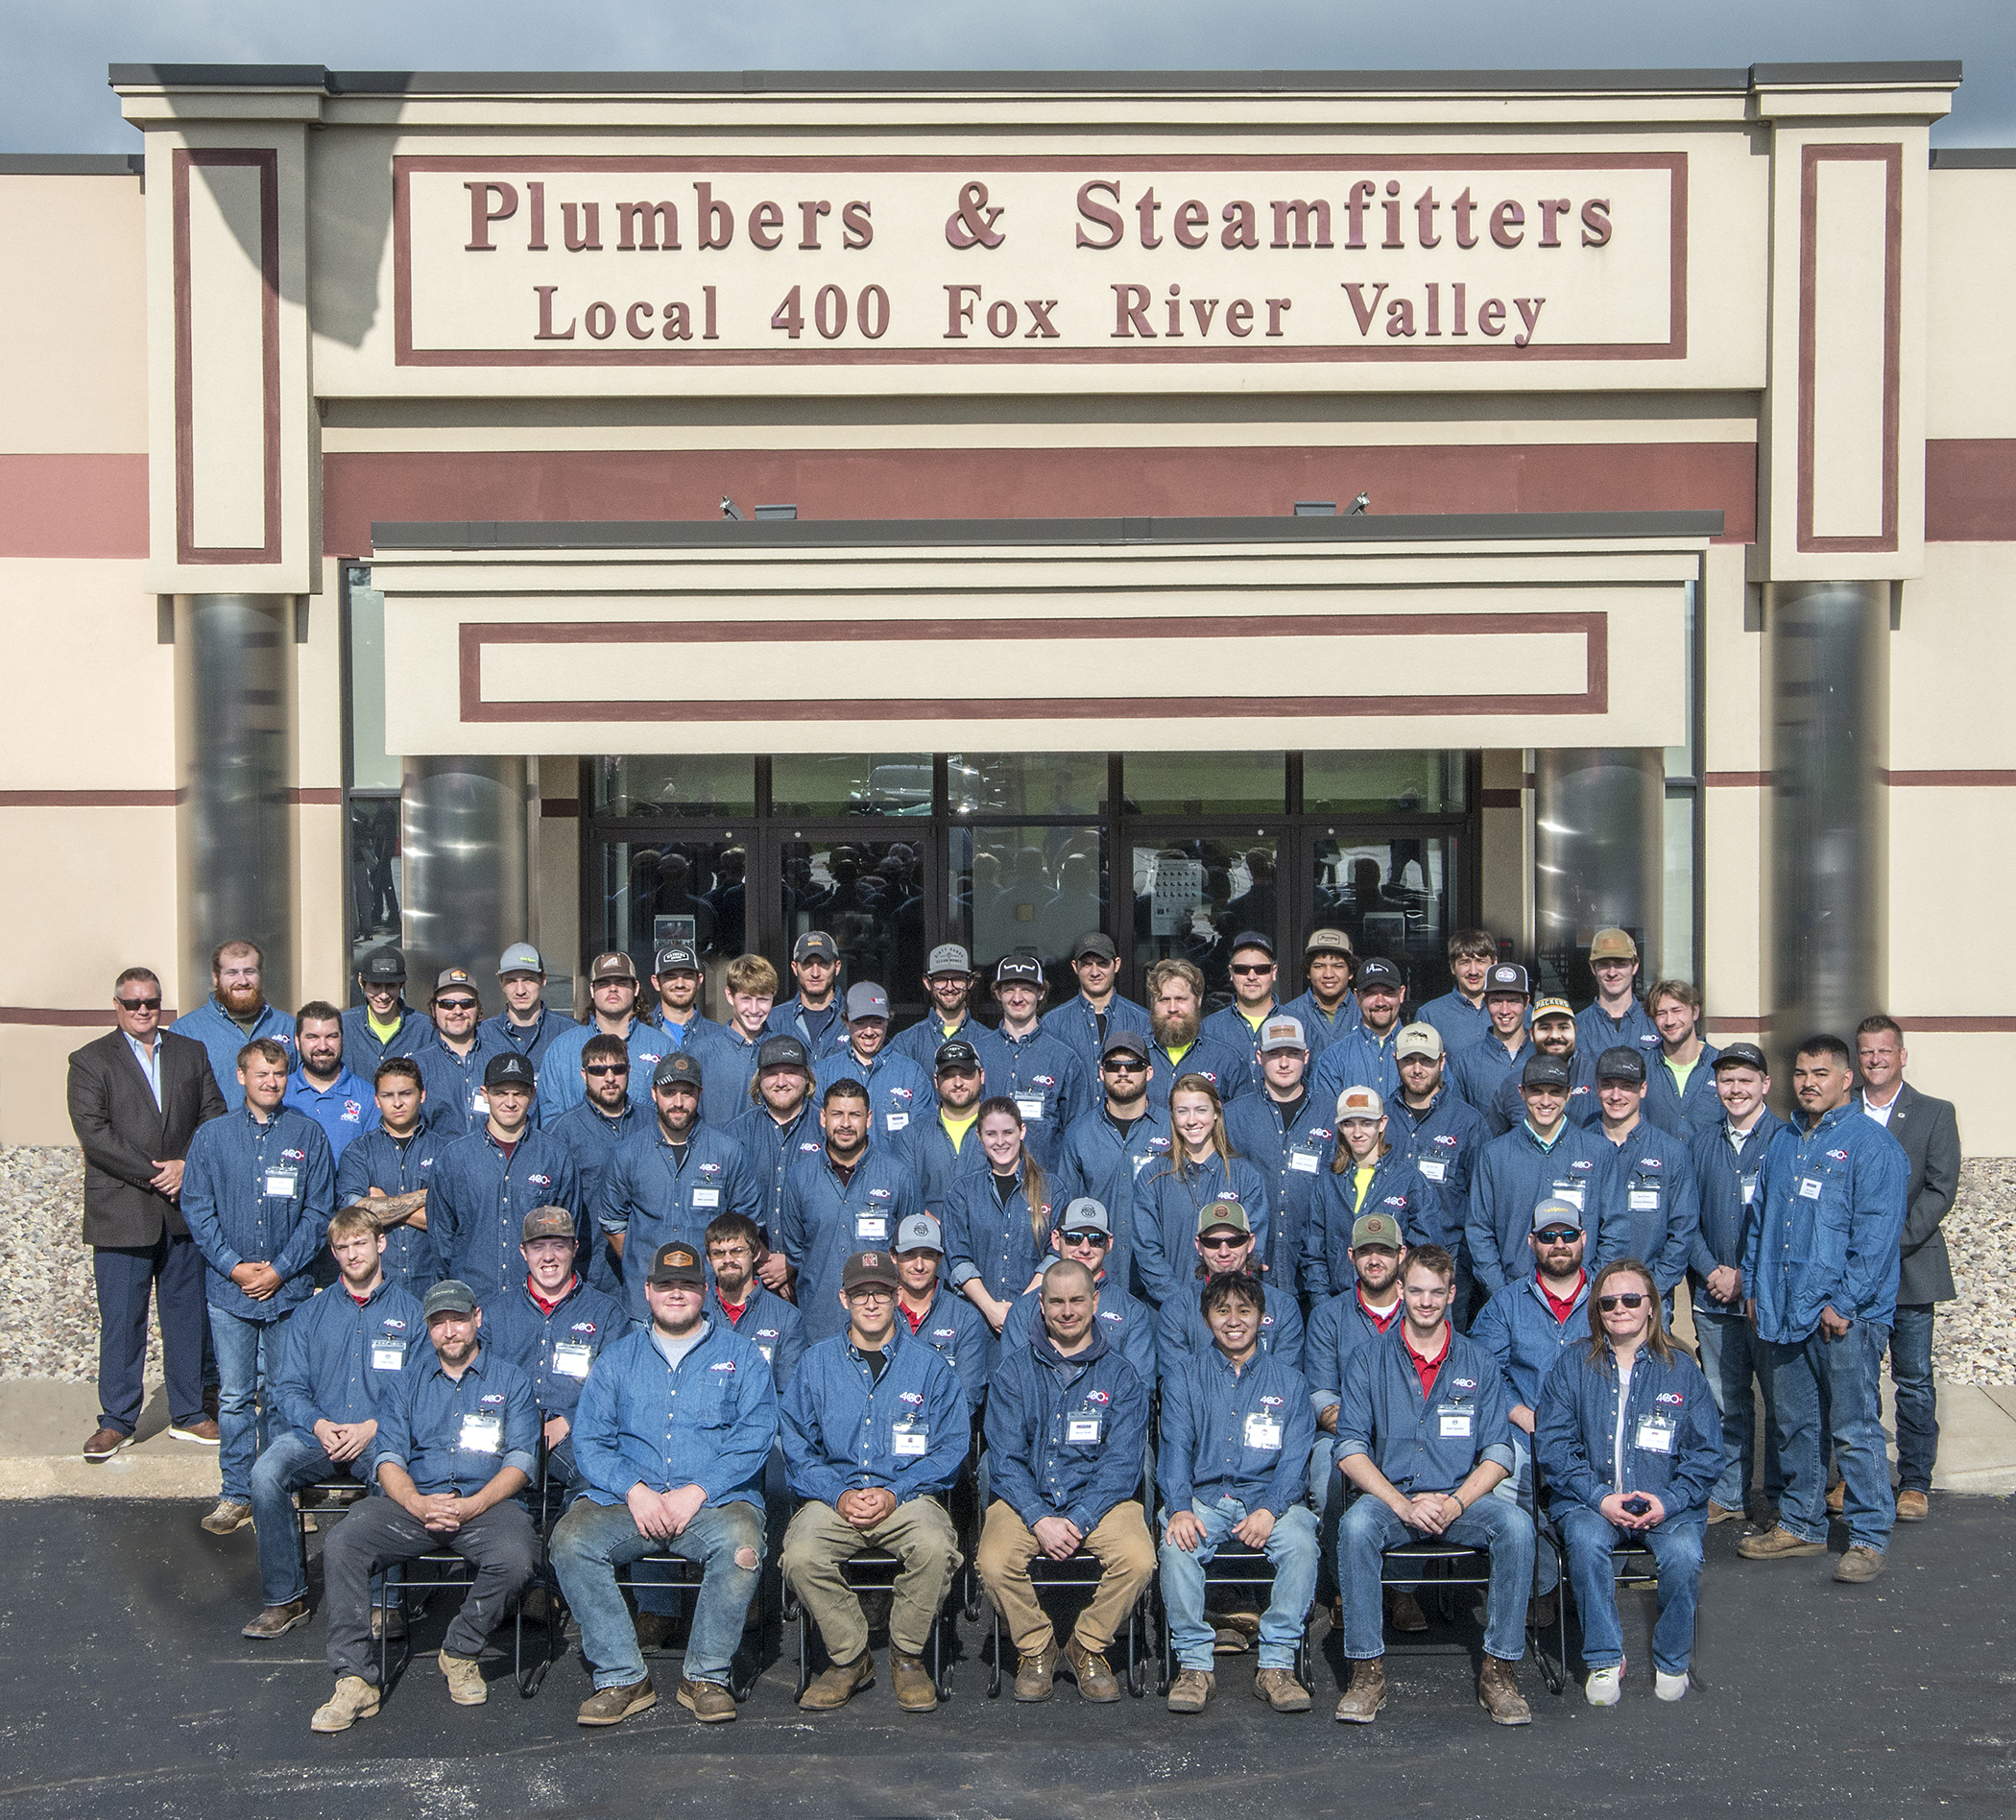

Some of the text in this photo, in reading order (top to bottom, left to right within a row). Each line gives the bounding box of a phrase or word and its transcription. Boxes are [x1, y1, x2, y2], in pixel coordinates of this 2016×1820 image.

[464, 180, 1612, 252] Plumbers & Steamfitters
[534, 282, 1546, 347] Local 400 Fox River Valley
[1535, 998, 1569, 1009] PACKERS
